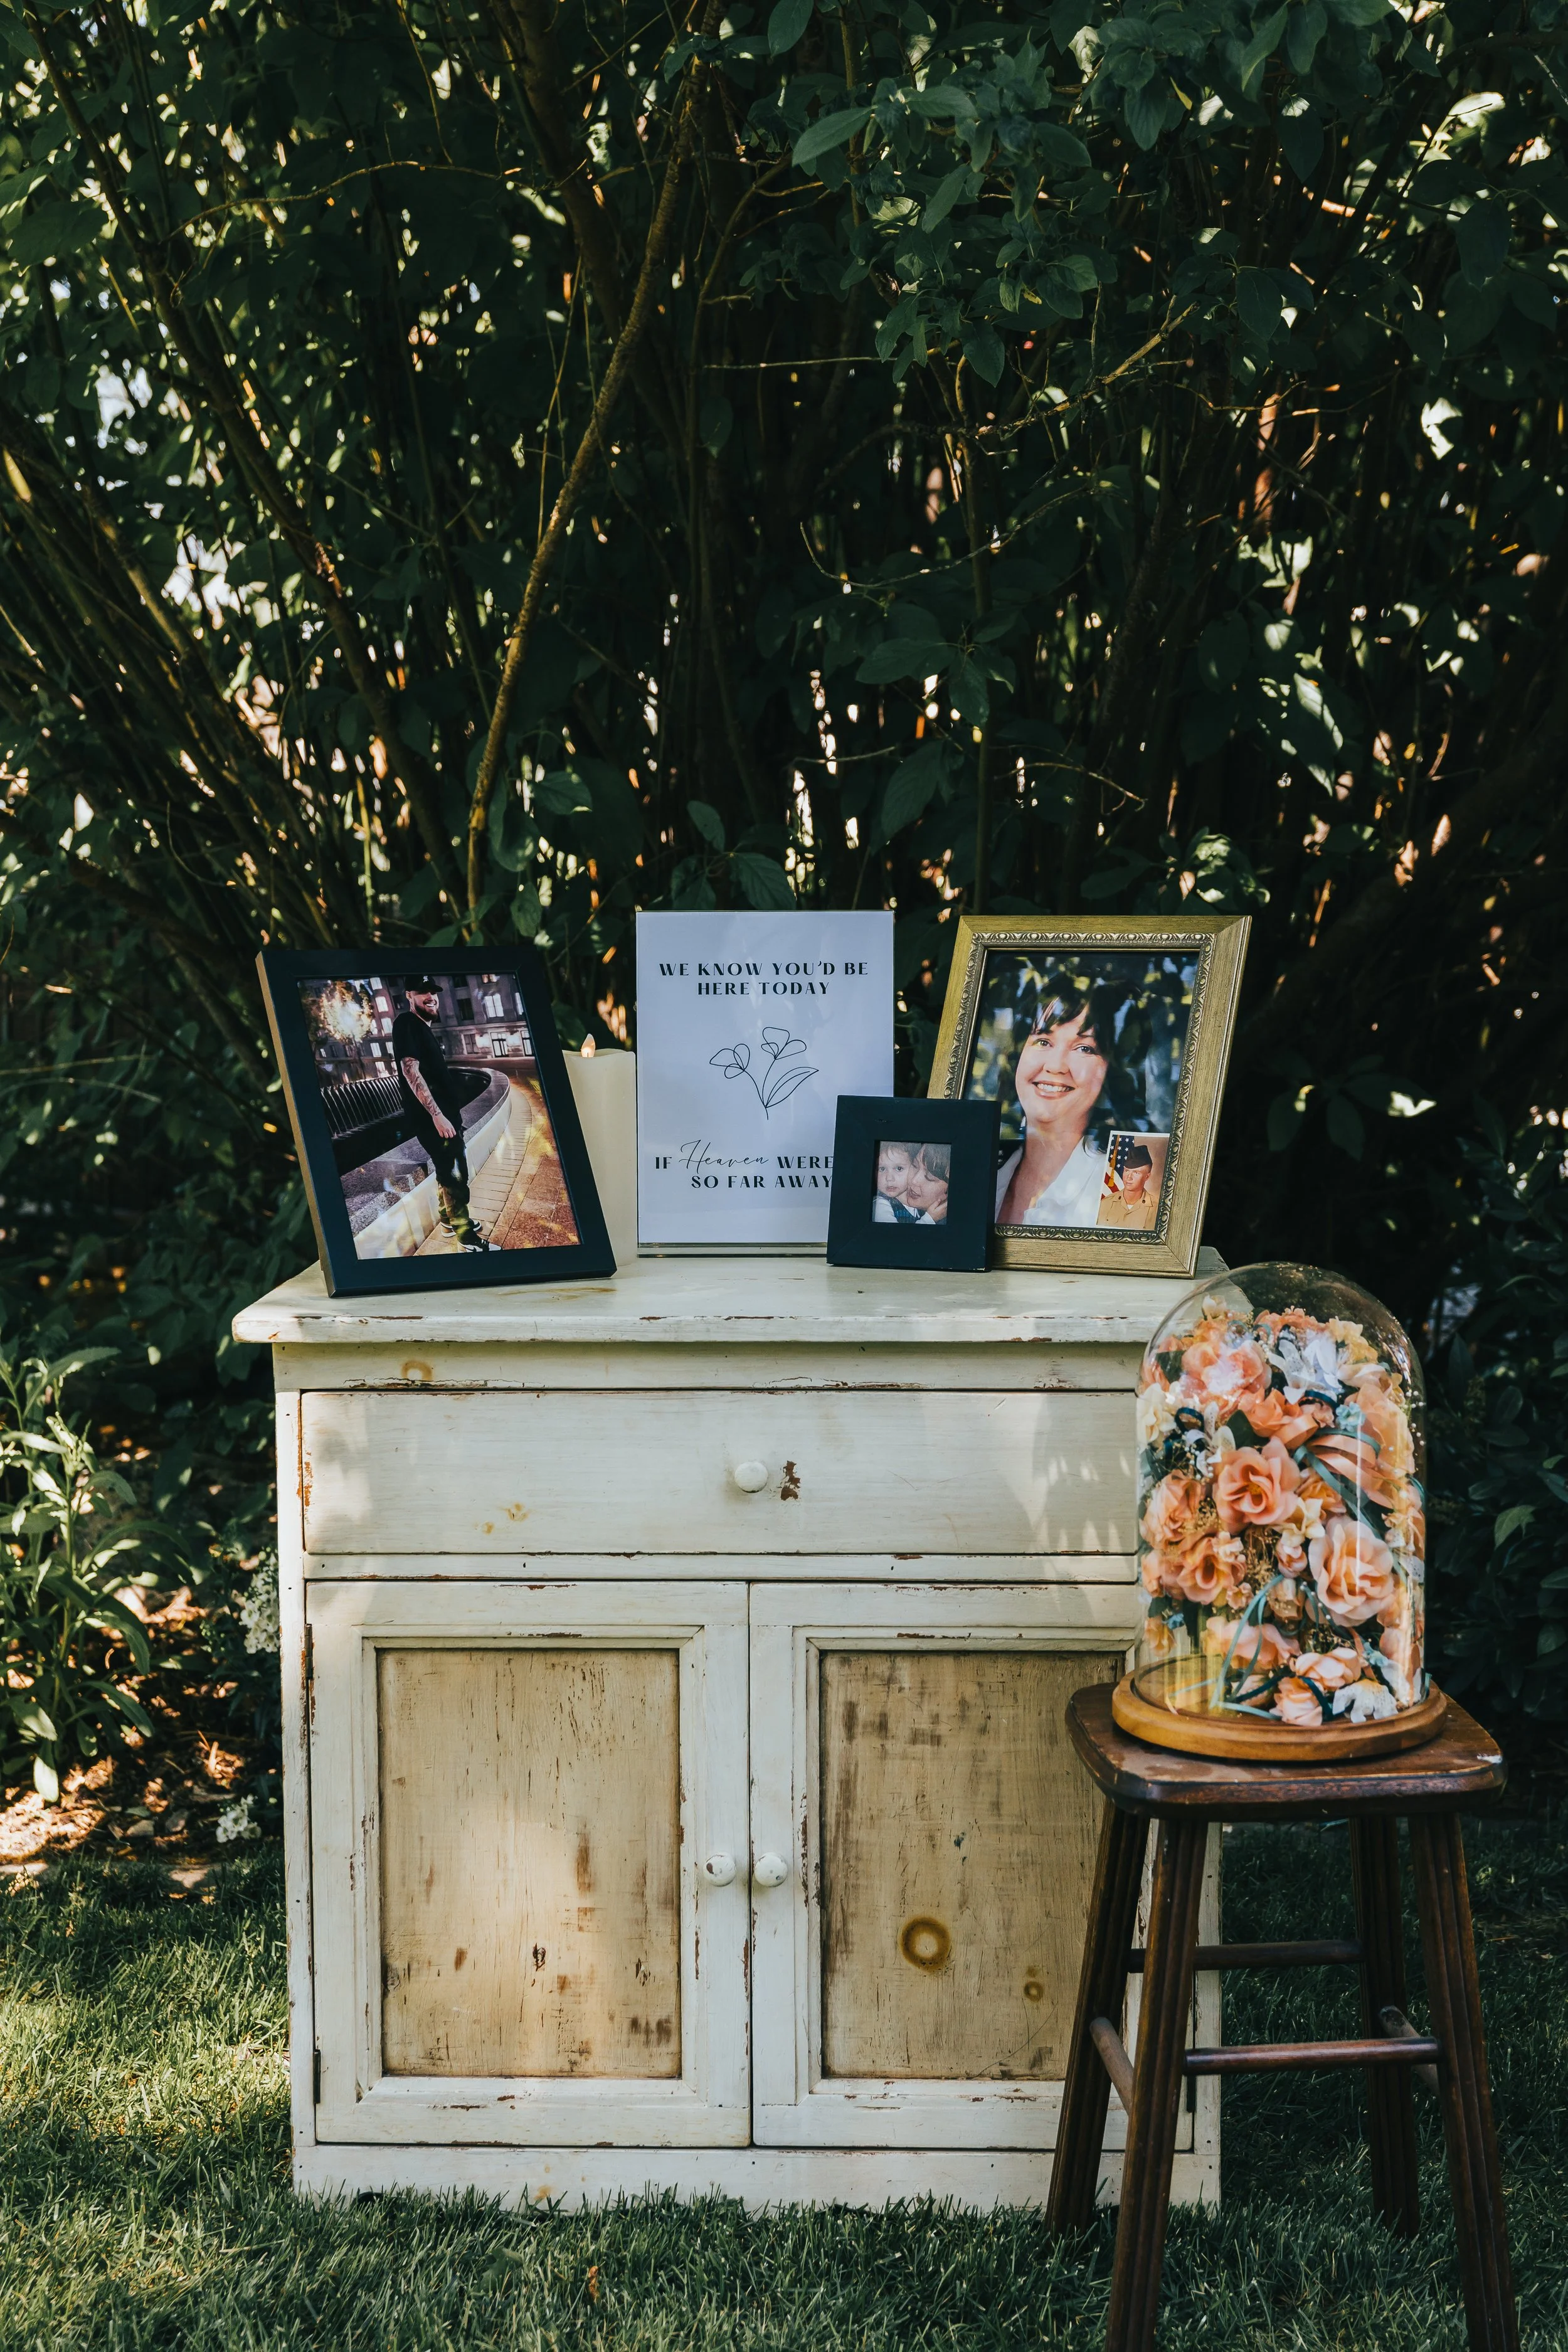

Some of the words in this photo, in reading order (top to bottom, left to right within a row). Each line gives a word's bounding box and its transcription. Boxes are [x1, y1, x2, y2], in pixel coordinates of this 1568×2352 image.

[659, 963, 689, 976] WE
[698, 963, 763, 976] KNOW
[844, 962, 869, 975] BE
[698, 982, 750, 995] HERE
[758, 982, 829, 995] TODAY
[655, 1157, 672, 1169] IF
[678, 1139, 769, 1174] Heaven
[776, 1156, 834, 1169] WERE
[691, 1175, 719, 1189] SO
[728, 1175, 766, 1188] FAR
[775, 1175, 832, 1188] AWAY
